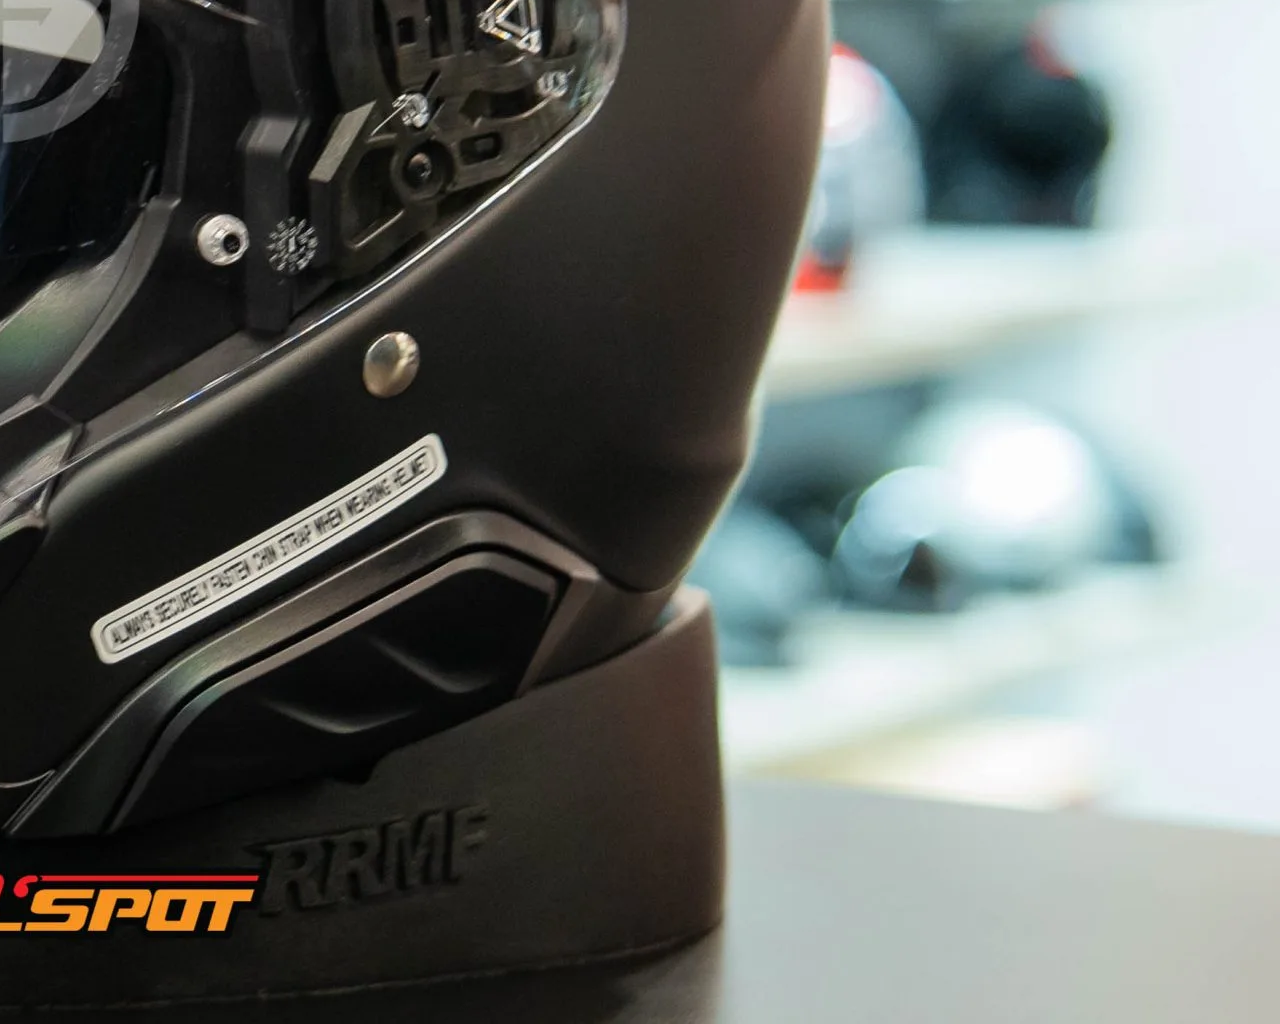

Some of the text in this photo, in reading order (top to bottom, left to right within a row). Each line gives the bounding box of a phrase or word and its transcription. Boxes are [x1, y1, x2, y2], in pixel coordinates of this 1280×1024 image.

[110, 609, 156, 645] ALWAYS
[154, 581, 210, 624] SECURELY
[210, 558, 252, 594] FASTEN
[252, 545, 278, 571] CHIN
[277, 524, 311, 557] STRAP
[313, 507, 344, 538] WHEN
[344, 478, 393, 517] WEARING
